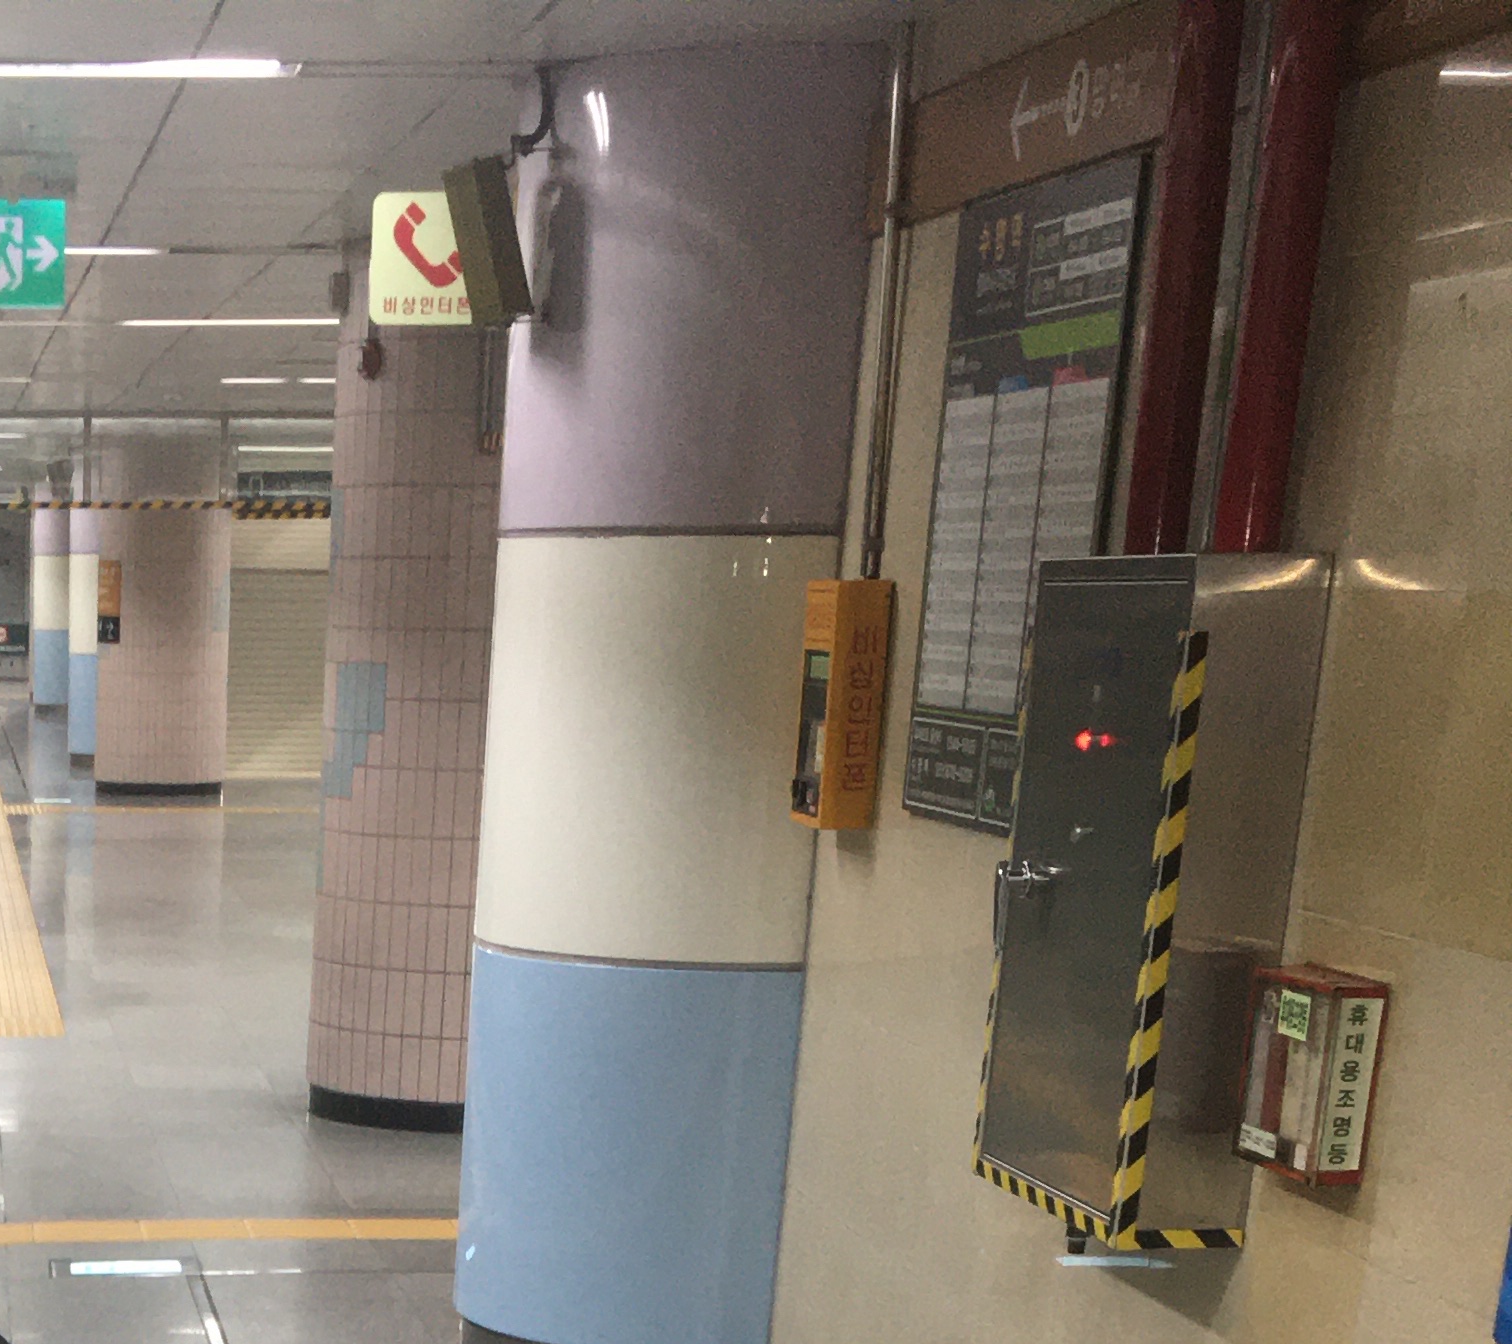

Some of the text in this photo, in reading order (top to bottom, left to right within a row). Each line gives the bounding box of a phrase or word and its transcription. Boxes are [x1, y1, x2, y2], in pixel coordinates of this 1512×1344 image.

[383, 296, 471, 316] 비상인터폰
[842, 624, 879, 792] 비상인터폰
[1327, 1003, 1369, 1166] 휴대용조명등
